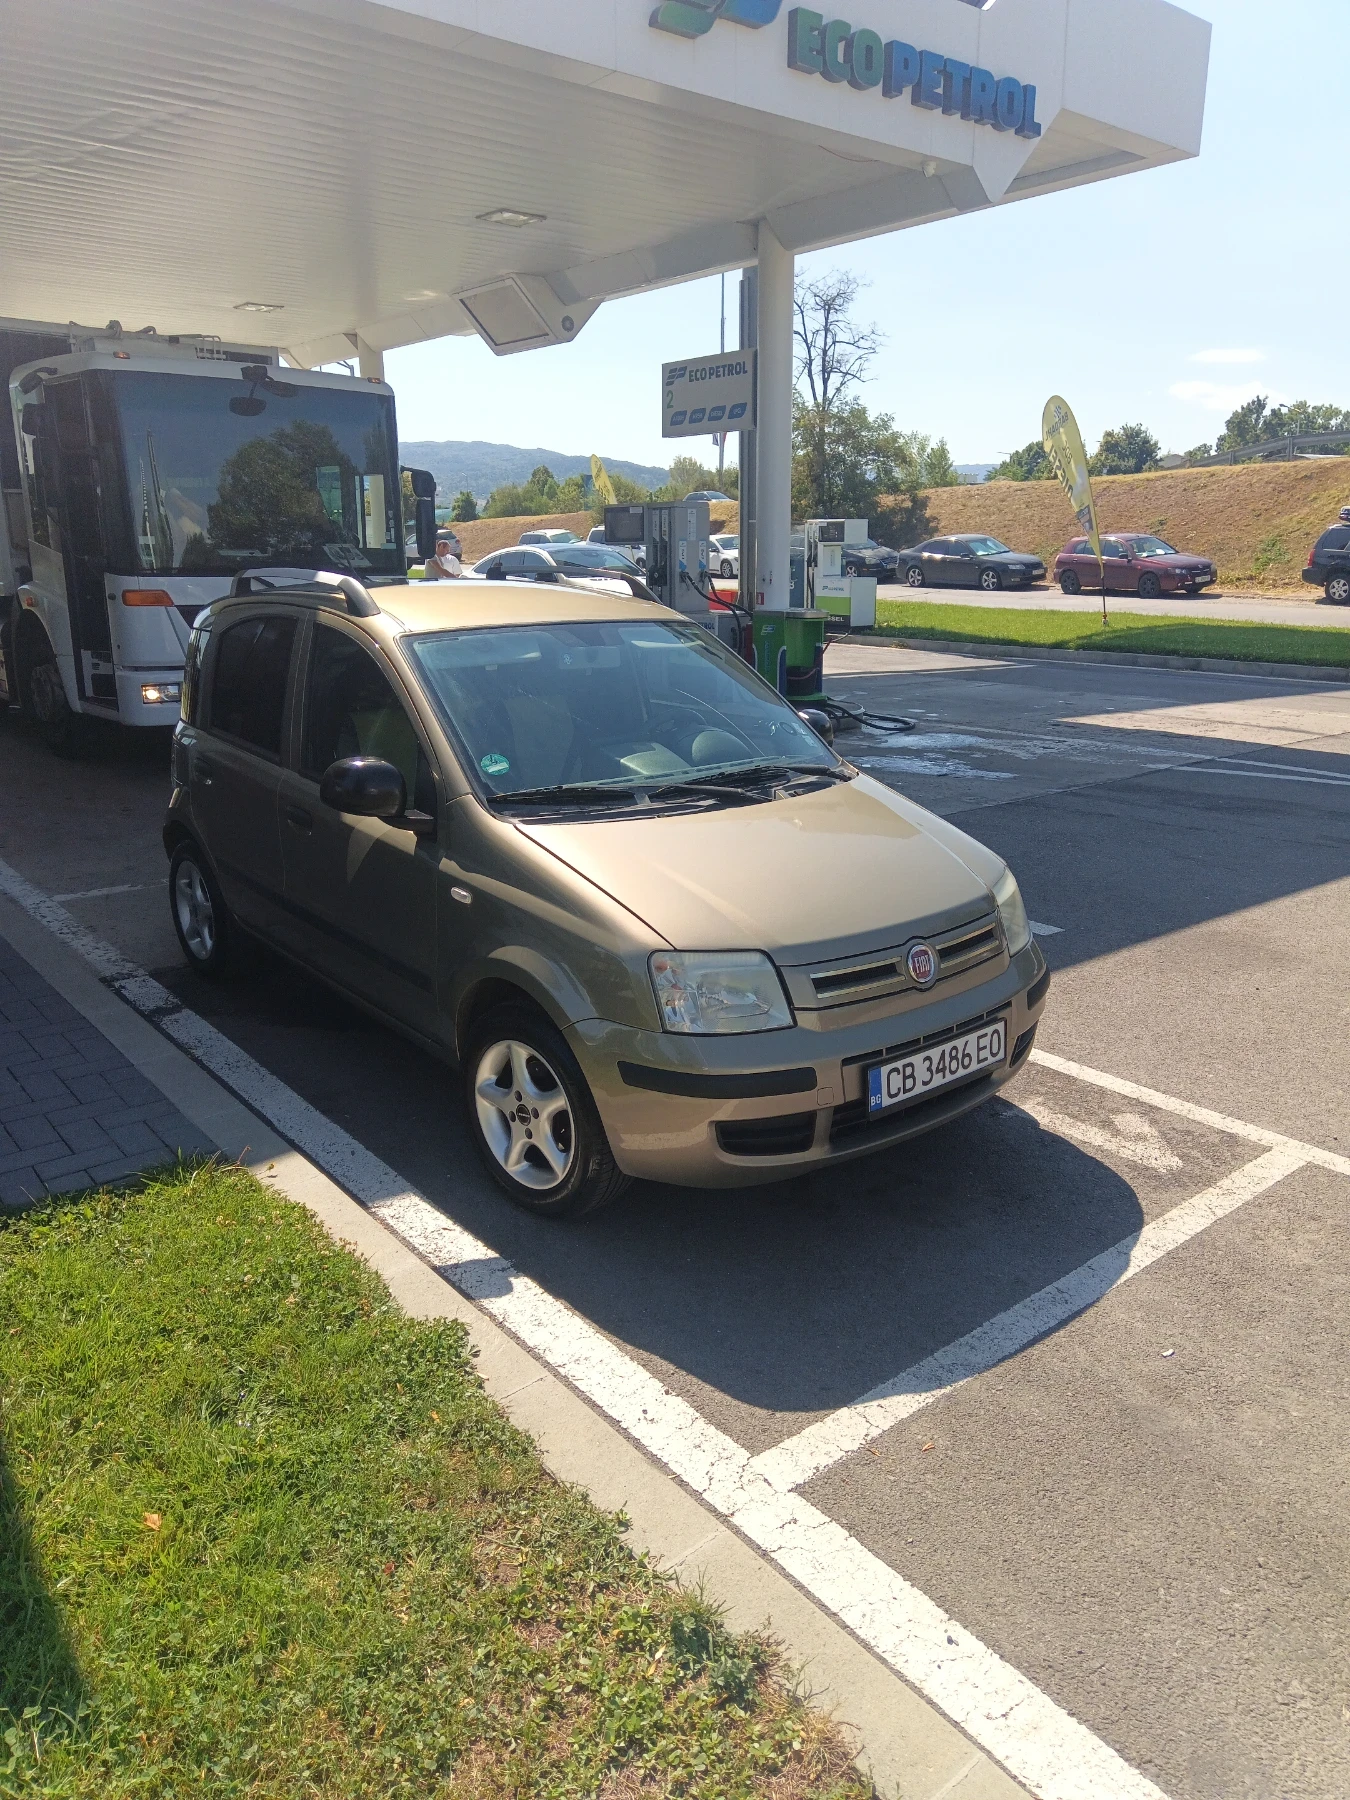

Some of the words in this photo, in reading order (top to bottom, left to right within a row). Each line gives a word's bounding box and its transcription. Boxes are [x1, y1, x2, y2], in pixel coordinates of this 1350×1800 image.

[666, 390, 674, 409] 2
[914, 954, 930, 974] FIAT
[870, 1093, 882, 1107] BG
